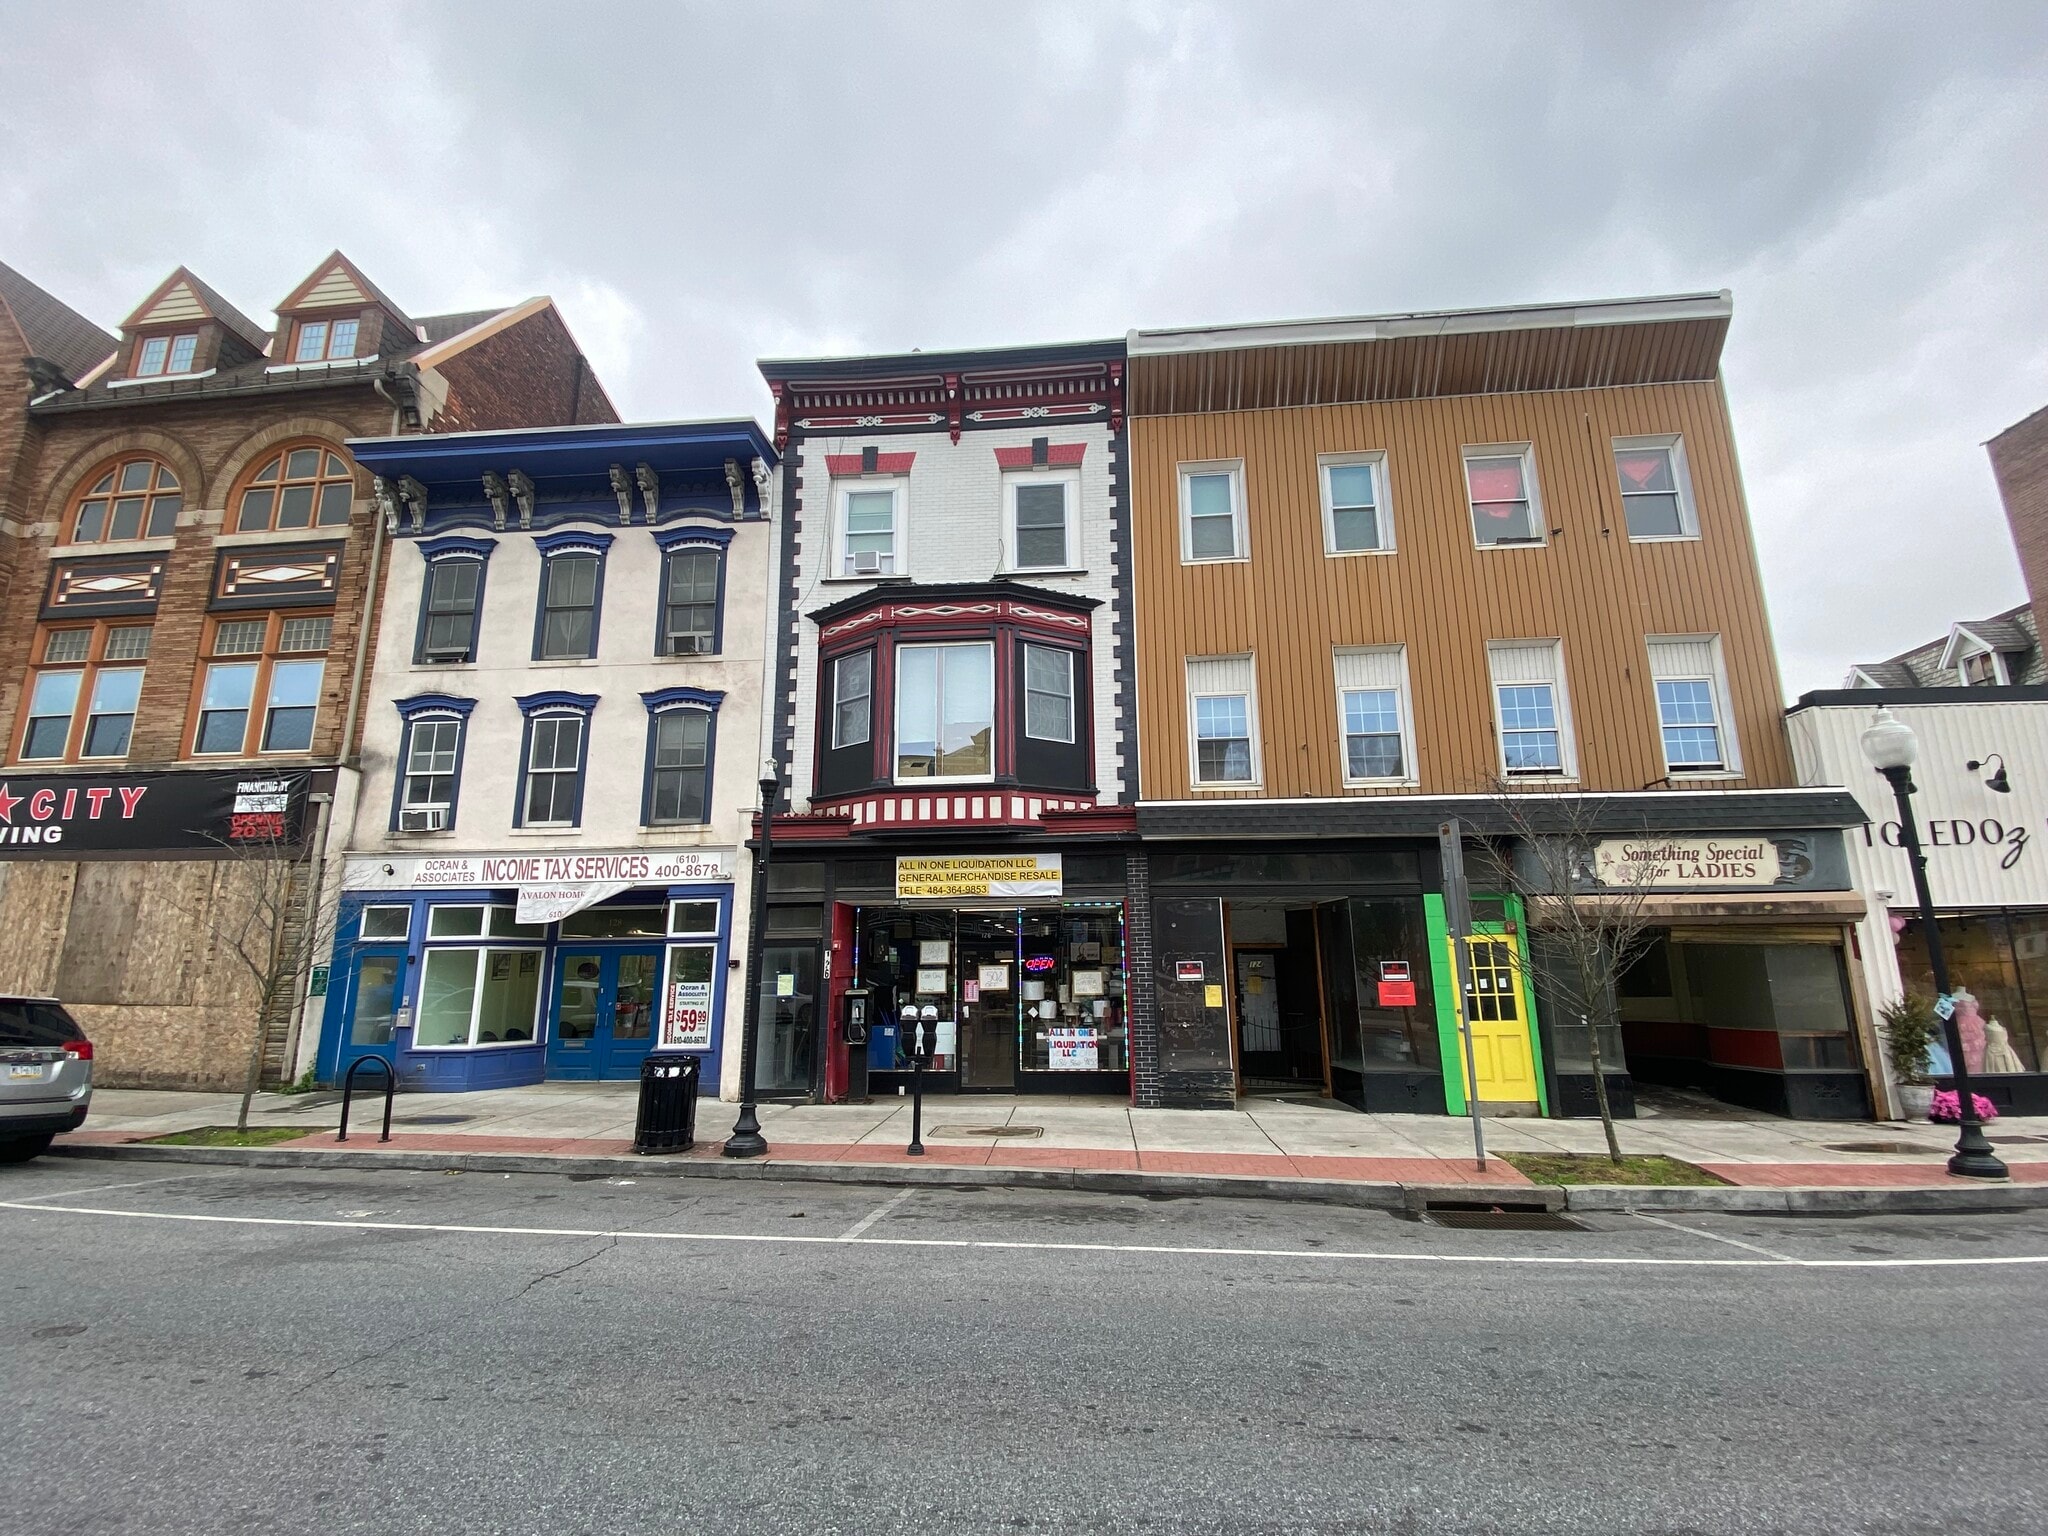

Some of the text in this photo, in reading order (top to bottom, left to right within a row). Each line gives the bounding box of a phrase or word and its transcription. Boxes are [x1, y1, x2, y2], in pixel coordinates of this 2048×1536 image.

[237, 781, 278, 792] FINANCING
[30, 786, 148, 821] CITY
[0, 826, 63, 844] ING
[230, 826, 283, 838] 2023
[1621, 842, 1764, 863] Something Special
[676, 855, 700, 864] (610)
[899, 861, 915, 870] ALL
[917, 861, 928, 869] IN
[930, 861, 950, 869] ONE
[952, 859, 1014, 869] LIQUIDATION
[425, 860, 468, 870] OCRAN &
[482, 856, 649, 880] INCOME TAX SERVICES
[655, 864, 719, 877] 400-8678
[1648, 863, 1756, 880] for LADIES
[415, 872, 475, 882] ASSOCIATES
[898, 873, 944, 882] GENERAL
[946, 872, 1016, 881] MERCHANDISE
[520, 891, 557, 900] AVALON
[1026, 959, 1055, 969] OPEN
[1049, 1028, 1095, 1037] ALL IN ONE
[1048, 1040, 1099, 1049] LIQUIDATION
[1062, 1049, 1077, 1057] LLC
